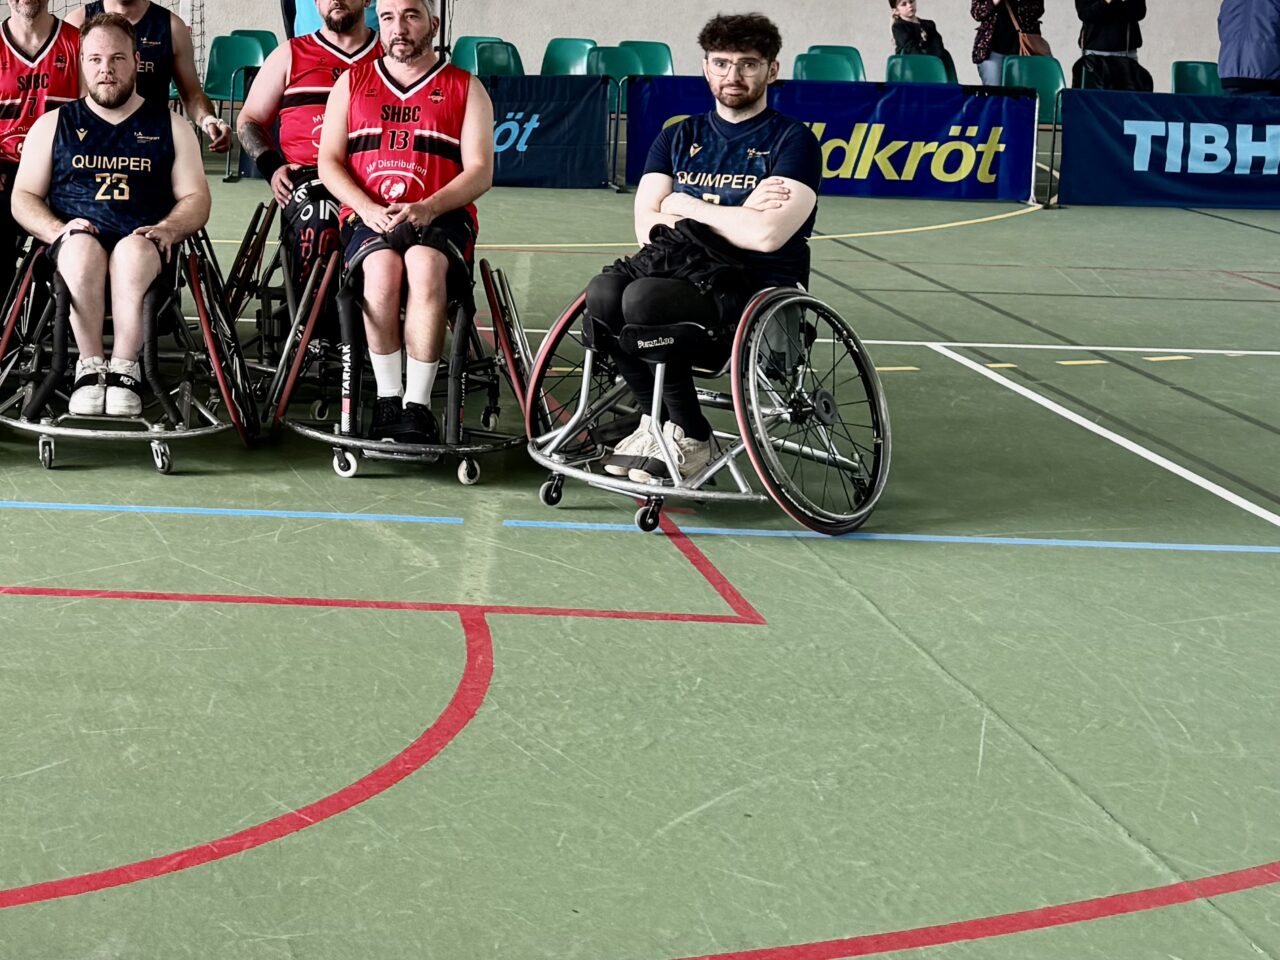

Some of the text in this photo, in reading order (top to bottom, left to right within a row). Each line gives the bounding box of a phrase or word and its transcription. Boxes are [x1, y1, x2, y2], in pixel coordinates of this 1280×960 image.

[28, 96, 38, 118] 7
[381, 104, 421, 123] SHBC
[388, 129, 410, 151] 13
[1123, 119, 1280, 175] TIBH
[72, 154, 152, 173] QUIMPER
[377, 159, 428, 176] Distribution
[94, 172, 130, 201] 23
[677, 170, 758, 189] QUIMPER
[341, 344, 352, 396] TARMAK
